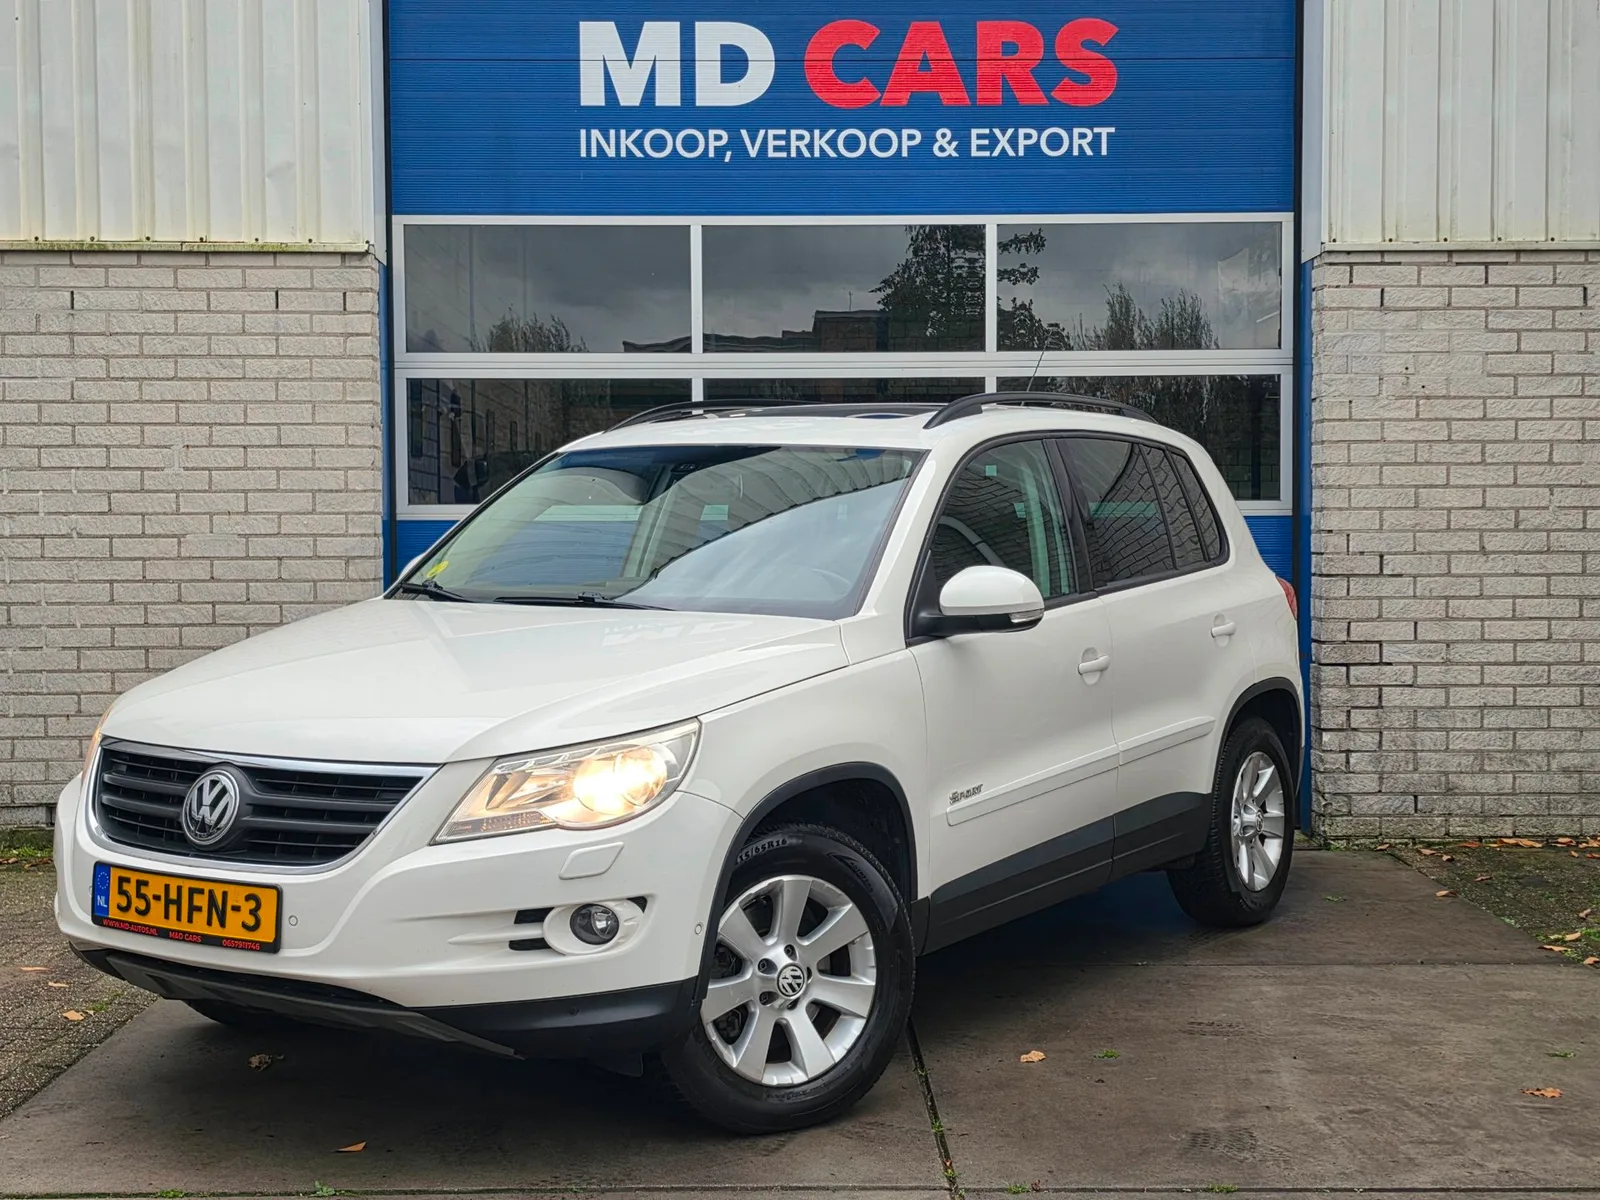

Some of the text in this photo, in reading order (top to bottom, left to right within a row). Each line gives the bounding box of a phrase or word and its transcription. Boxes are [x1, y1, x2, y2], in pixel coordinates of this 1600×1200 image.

[579, 18, 1120, 108] MD CARS
[579, 127, 1116, 162] INKOOP, VERKOOP & EXPORT
[96, 894, 109, 908] NL
[116, 875, 262, 933] 55-HFN-3
[184, 932, 202, 943] CARS
